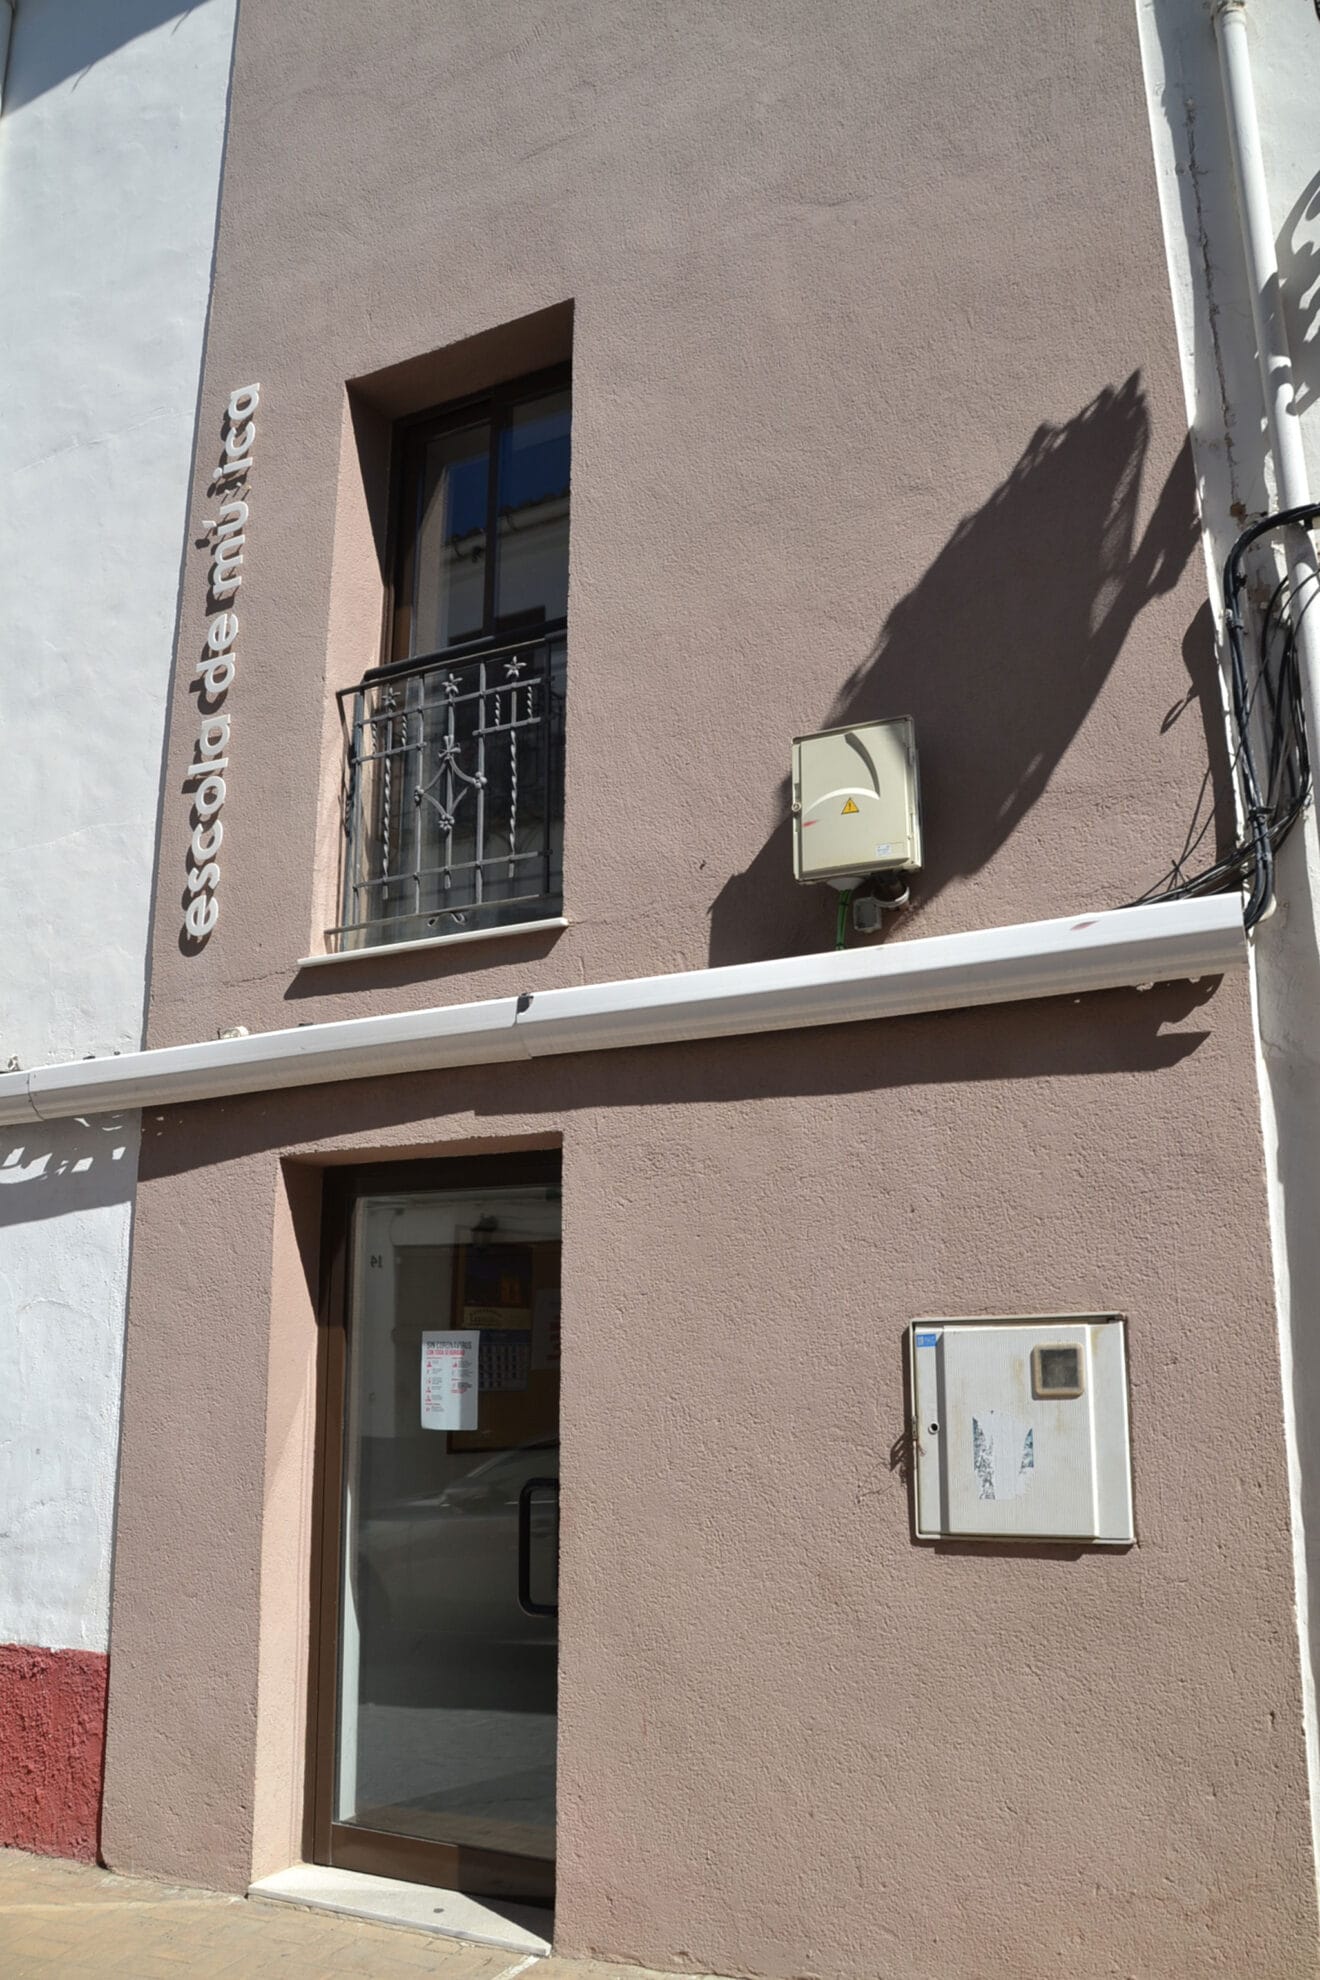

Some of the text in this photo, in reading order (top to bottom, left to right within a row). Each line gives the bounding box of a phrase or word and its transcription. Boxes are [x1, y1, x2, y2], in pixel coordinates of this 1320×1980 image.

[185, 383, 260, 937] escola de múica
